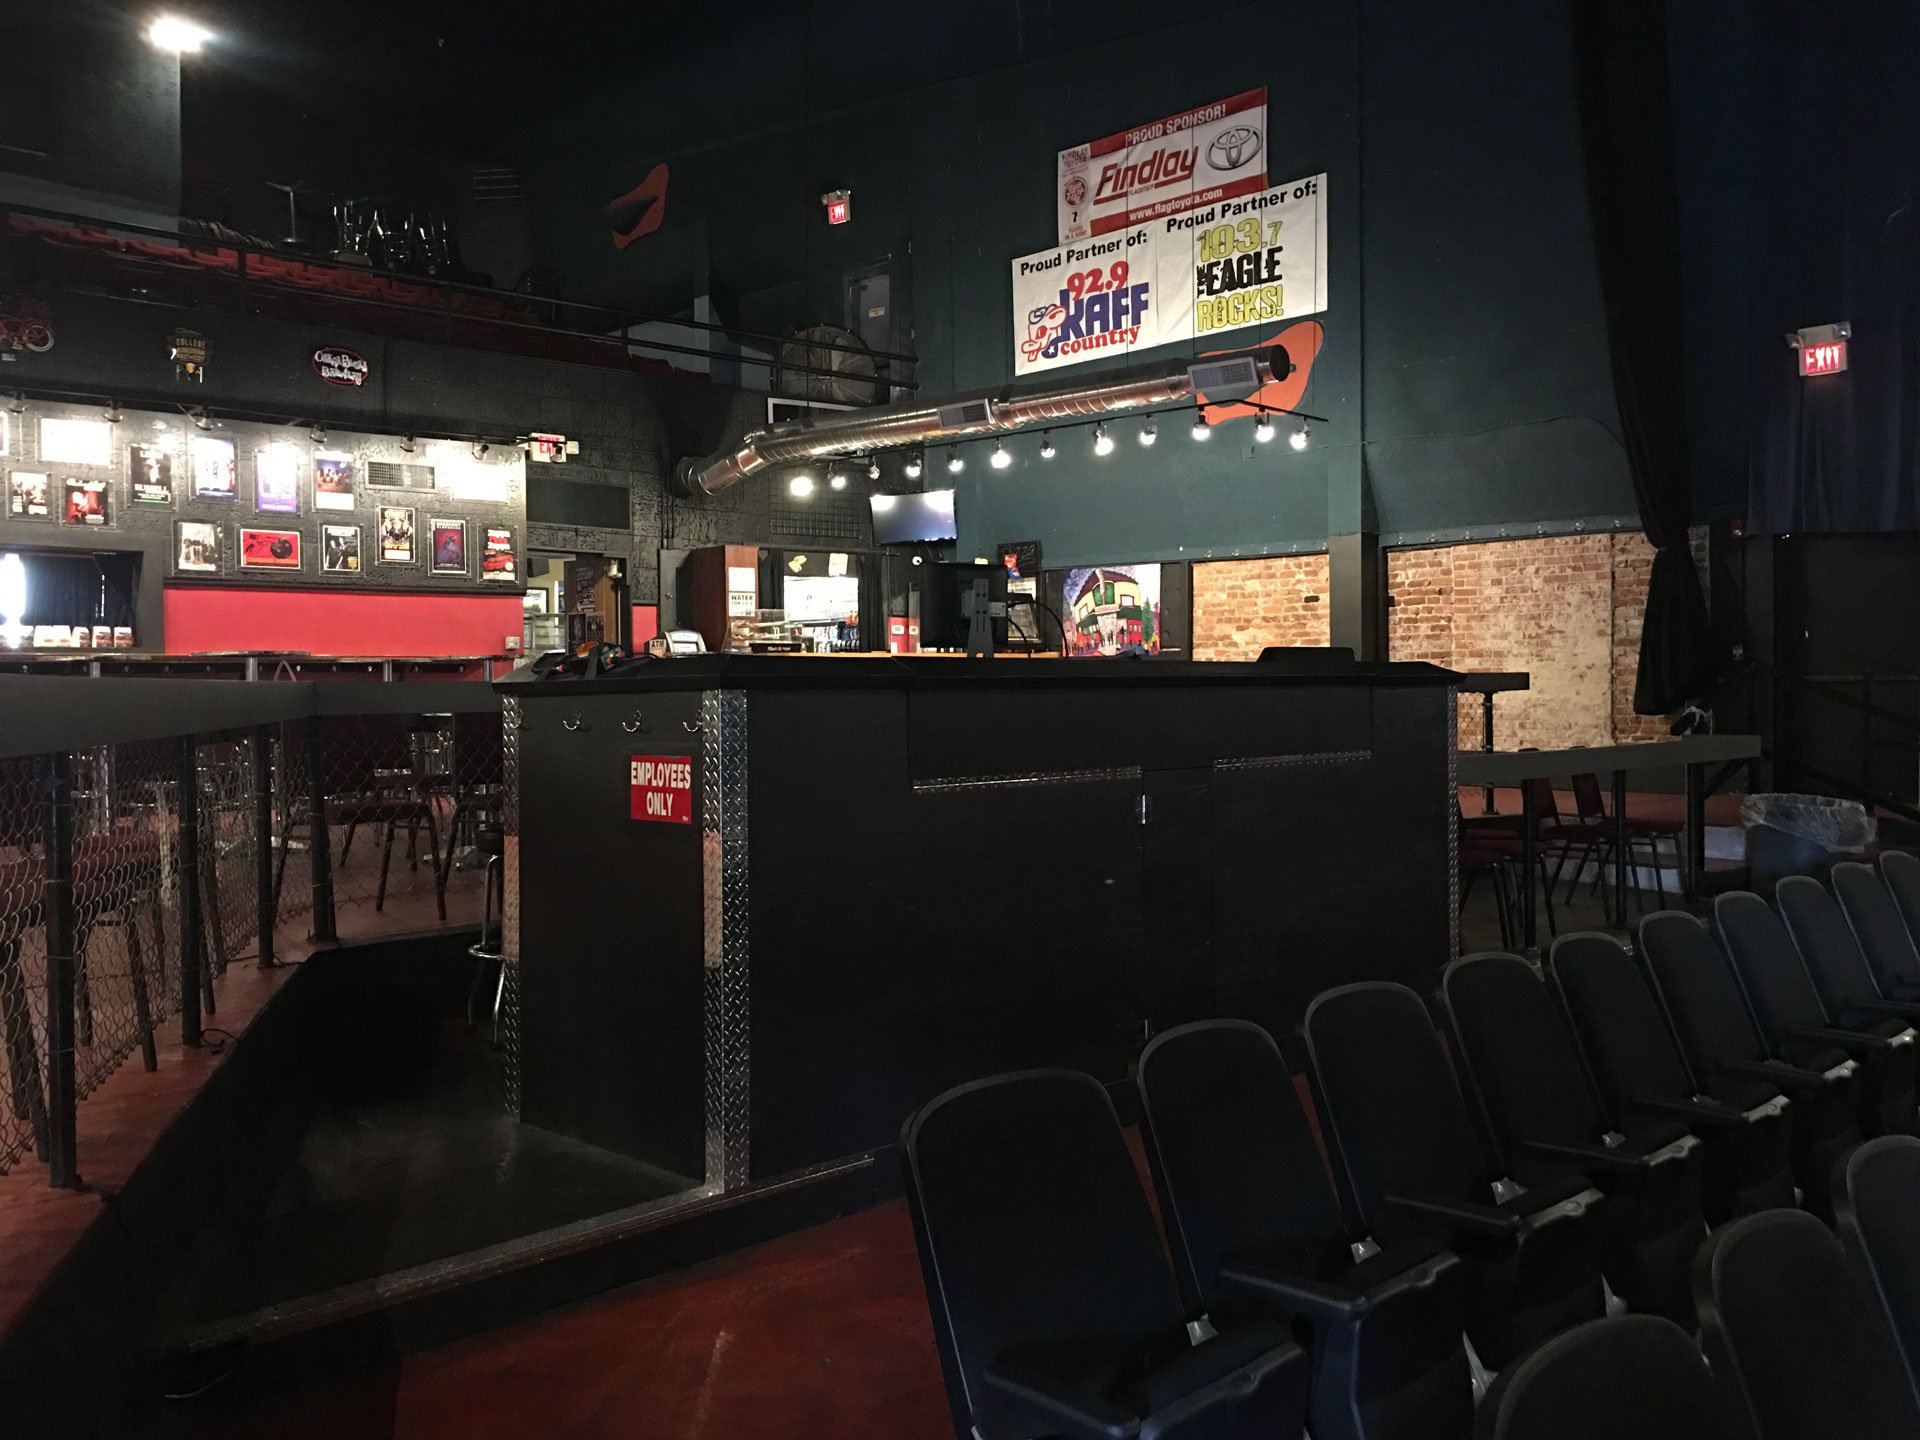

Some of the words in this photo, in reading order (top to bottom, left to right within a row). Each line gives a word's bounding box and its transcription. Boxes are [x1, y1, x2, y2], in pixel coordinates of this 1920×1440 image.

[1125, 123, 1163, 146] PROUD
[1166, 104, 1227, 135] SPONSOR!
[1095, 145, 1199, 197] Findlay
[1071, 211, 1078, 223] 7
[1128, 187, 1223, 222] www.flagtoyota.com
[1166, 209, 1216, 233] Proud
[1221, 190, 1290, 218] Partner
[1293, 181, 1318, 199] of:
[1020, 254, 1062, 276] Proud
[1066, 238, 1122, 263] Partner
[1126, 230, 1148, 247] of:
[1196, 217, 1284, 263] 103.7
[1066, 260, 1130, 301] 92.9
[1206, 246, 1284, 297] EAGLE
[1059, 282, 1150, 341] KAFF
[1196, 285, 1284, 333] ROCKS!
[1060, 325, 1141, 356] country
[1805, 345, 1842, 373] EXIT
[651, 640, 665, 648] ATM
[631, 761, 692, 790] EMPLOYEES
[646, 791, 674, 816] ONLY
